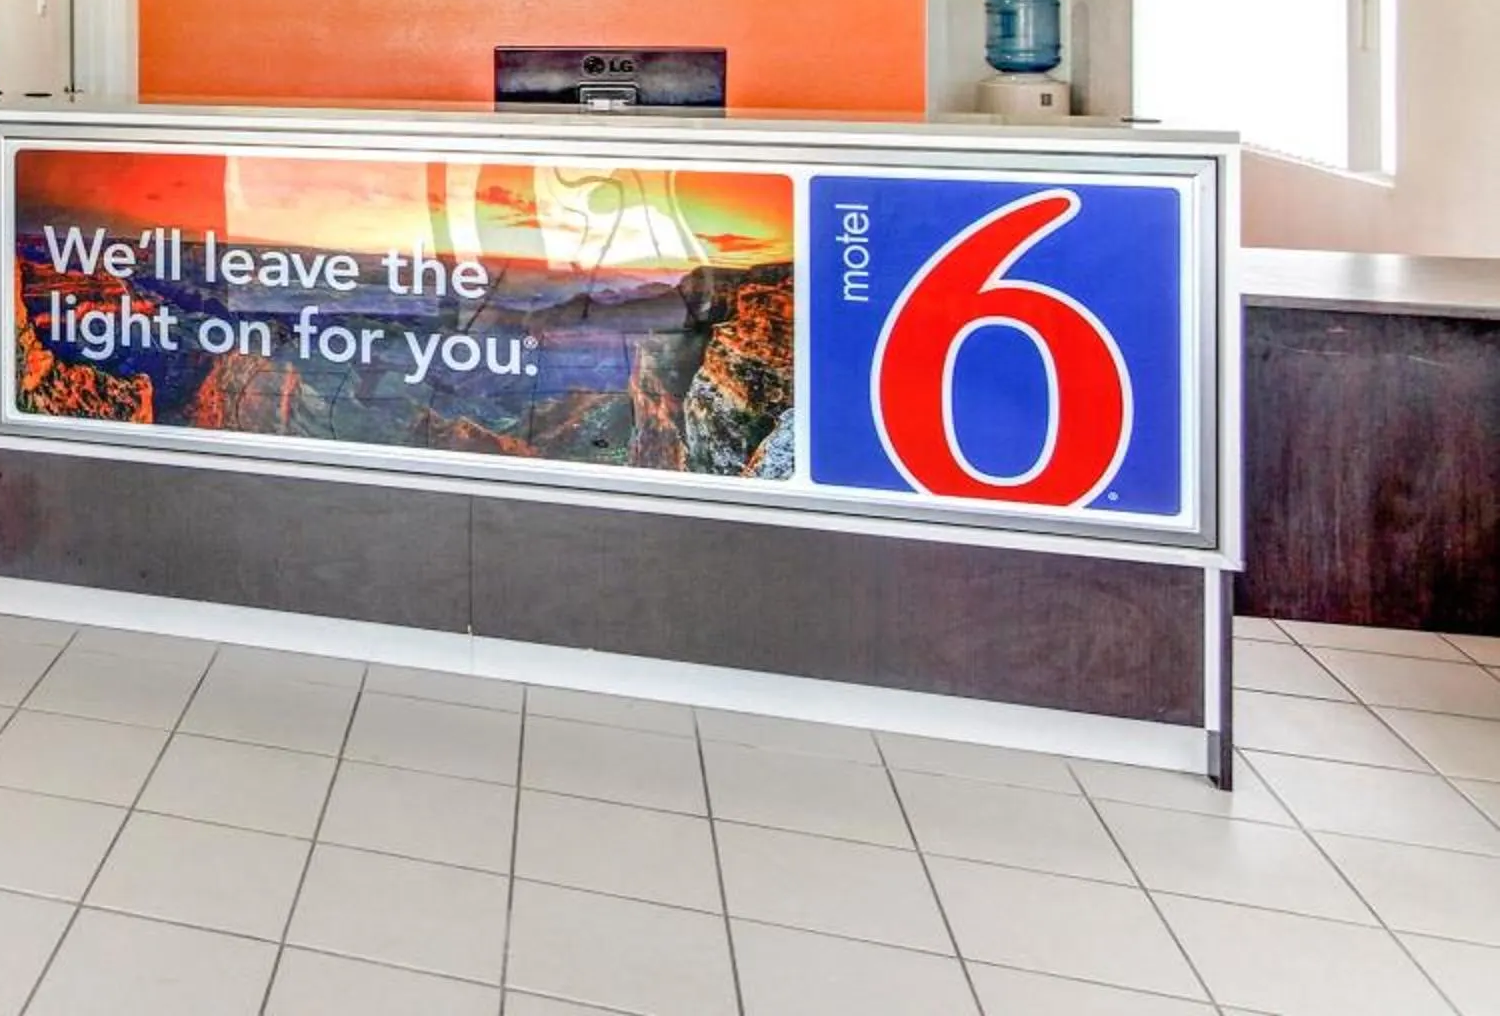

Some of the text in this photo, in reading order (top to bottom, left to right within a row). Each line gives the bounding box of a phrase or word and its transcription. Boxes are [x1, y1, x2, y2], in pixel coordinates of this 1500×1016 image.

[609, 60, 633, 73] LG
[44, 225, 489, 299] We'll leave the
[835, 203, 870, 302] motel
[49, 291, 179, 361] light
[200, 317, 272, 357] on
[293, 306, 385, 365] for
[869, 187, 1135, 509] 6
